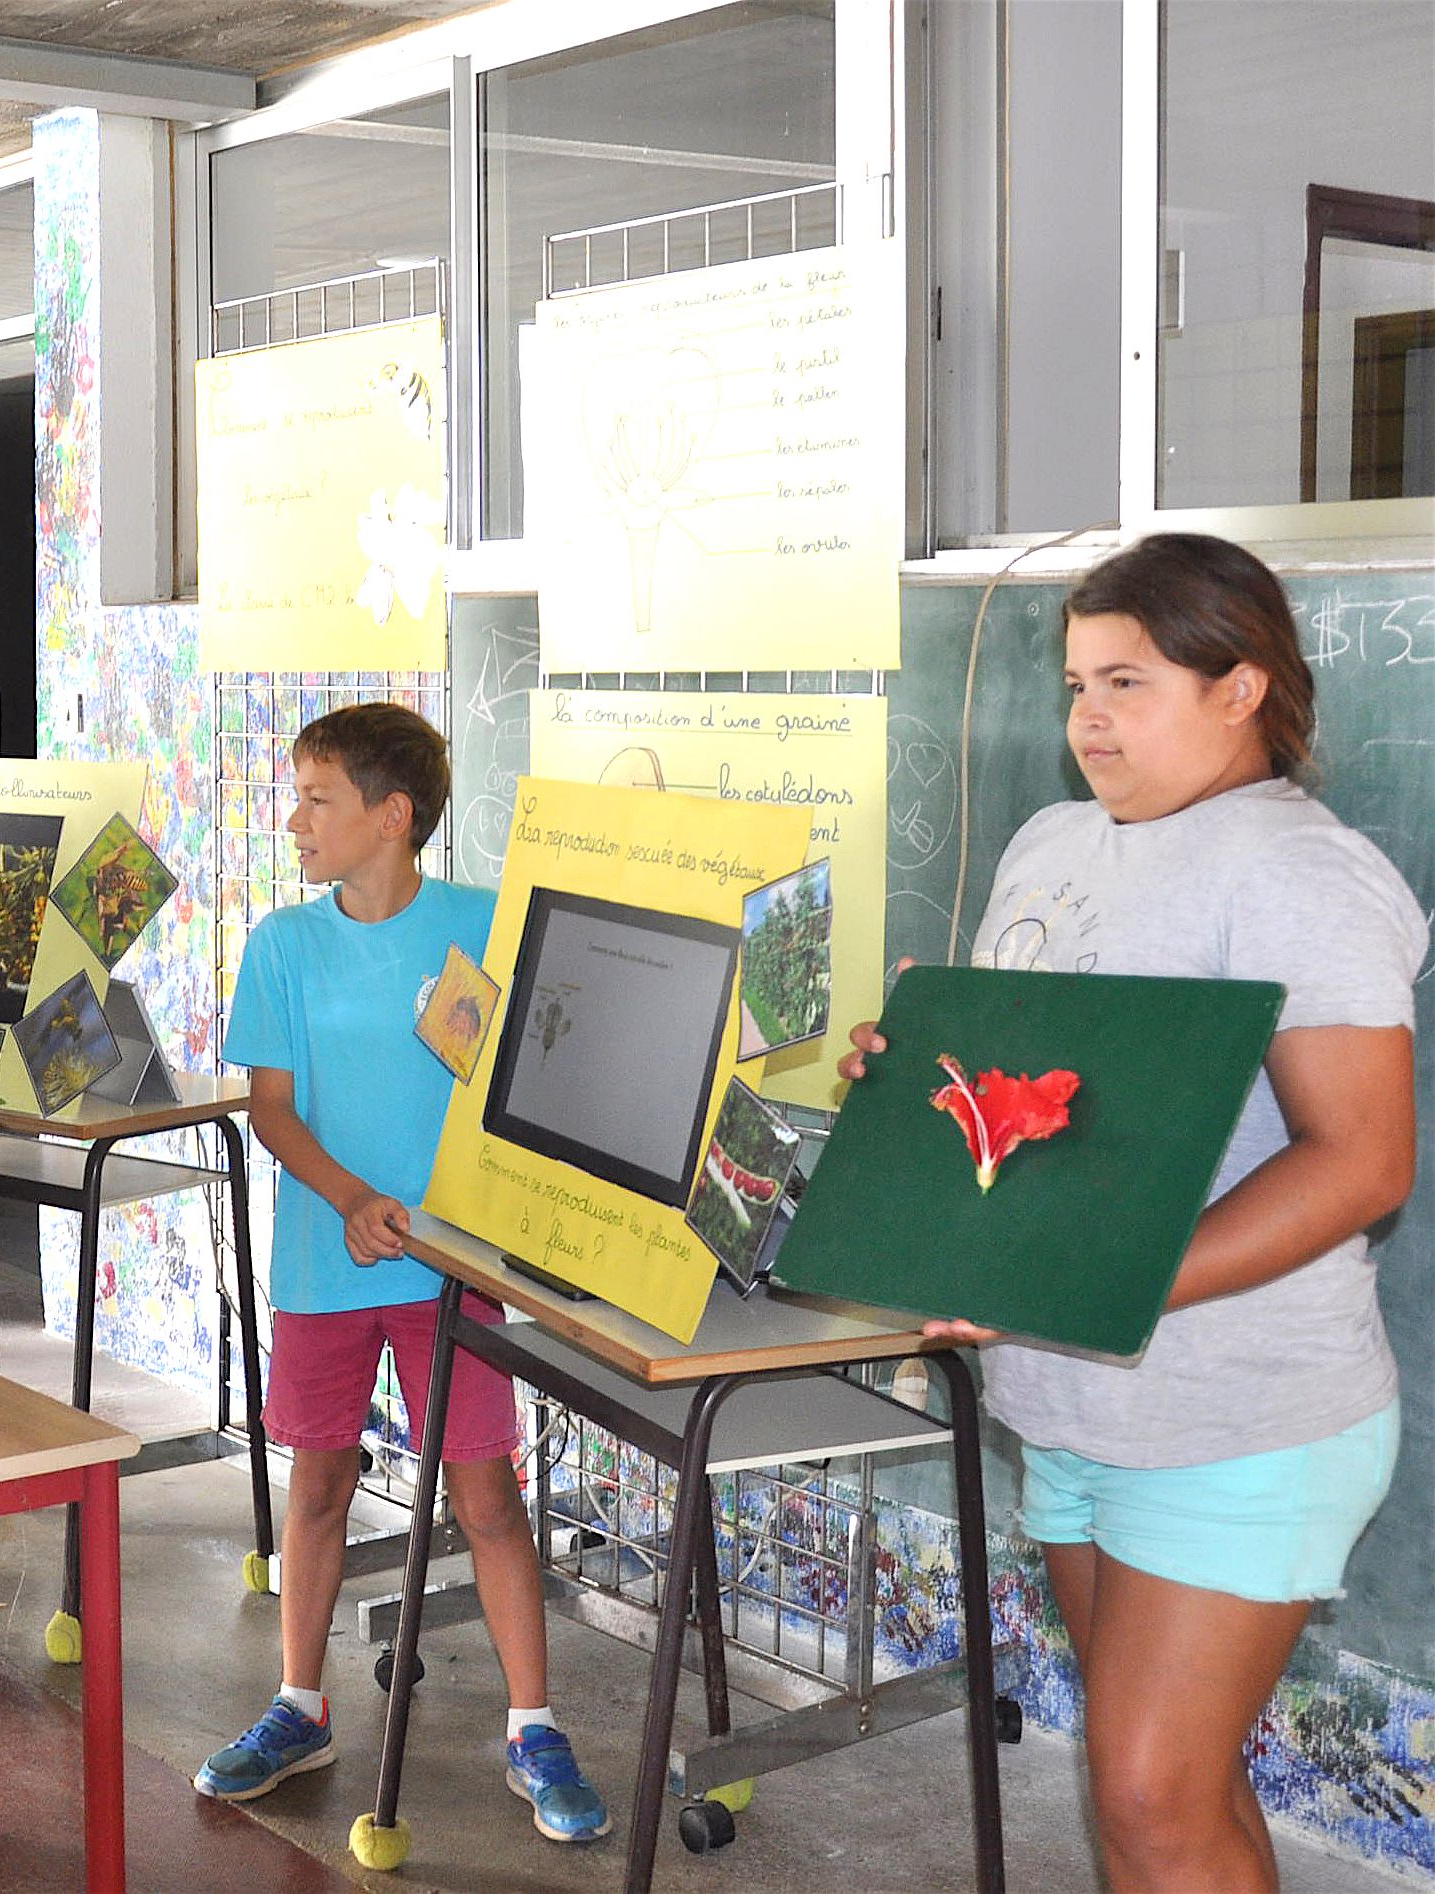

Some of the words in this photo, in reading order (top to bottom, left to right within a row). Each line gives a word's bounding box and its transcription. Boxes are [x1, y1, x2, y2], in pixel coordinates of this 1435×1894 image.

[776, 536, 796, 555] les
[551, 693, 574, 724] la
[584, 706, 692, 731] composition
[775, 714, 853, 742] graine
[719, 763, 742, 801] les
[745, 770, 854, 805] cotylédons
[810, 817, 841, 842] ent
[676, 849, 698, 871] des
[519, 1205, 530, 1236] à
[543, 1217, 584, 1266] fleurs
[592, 1233, 605, 1259] ?
[644, 1223, 693, 1262] plantes
